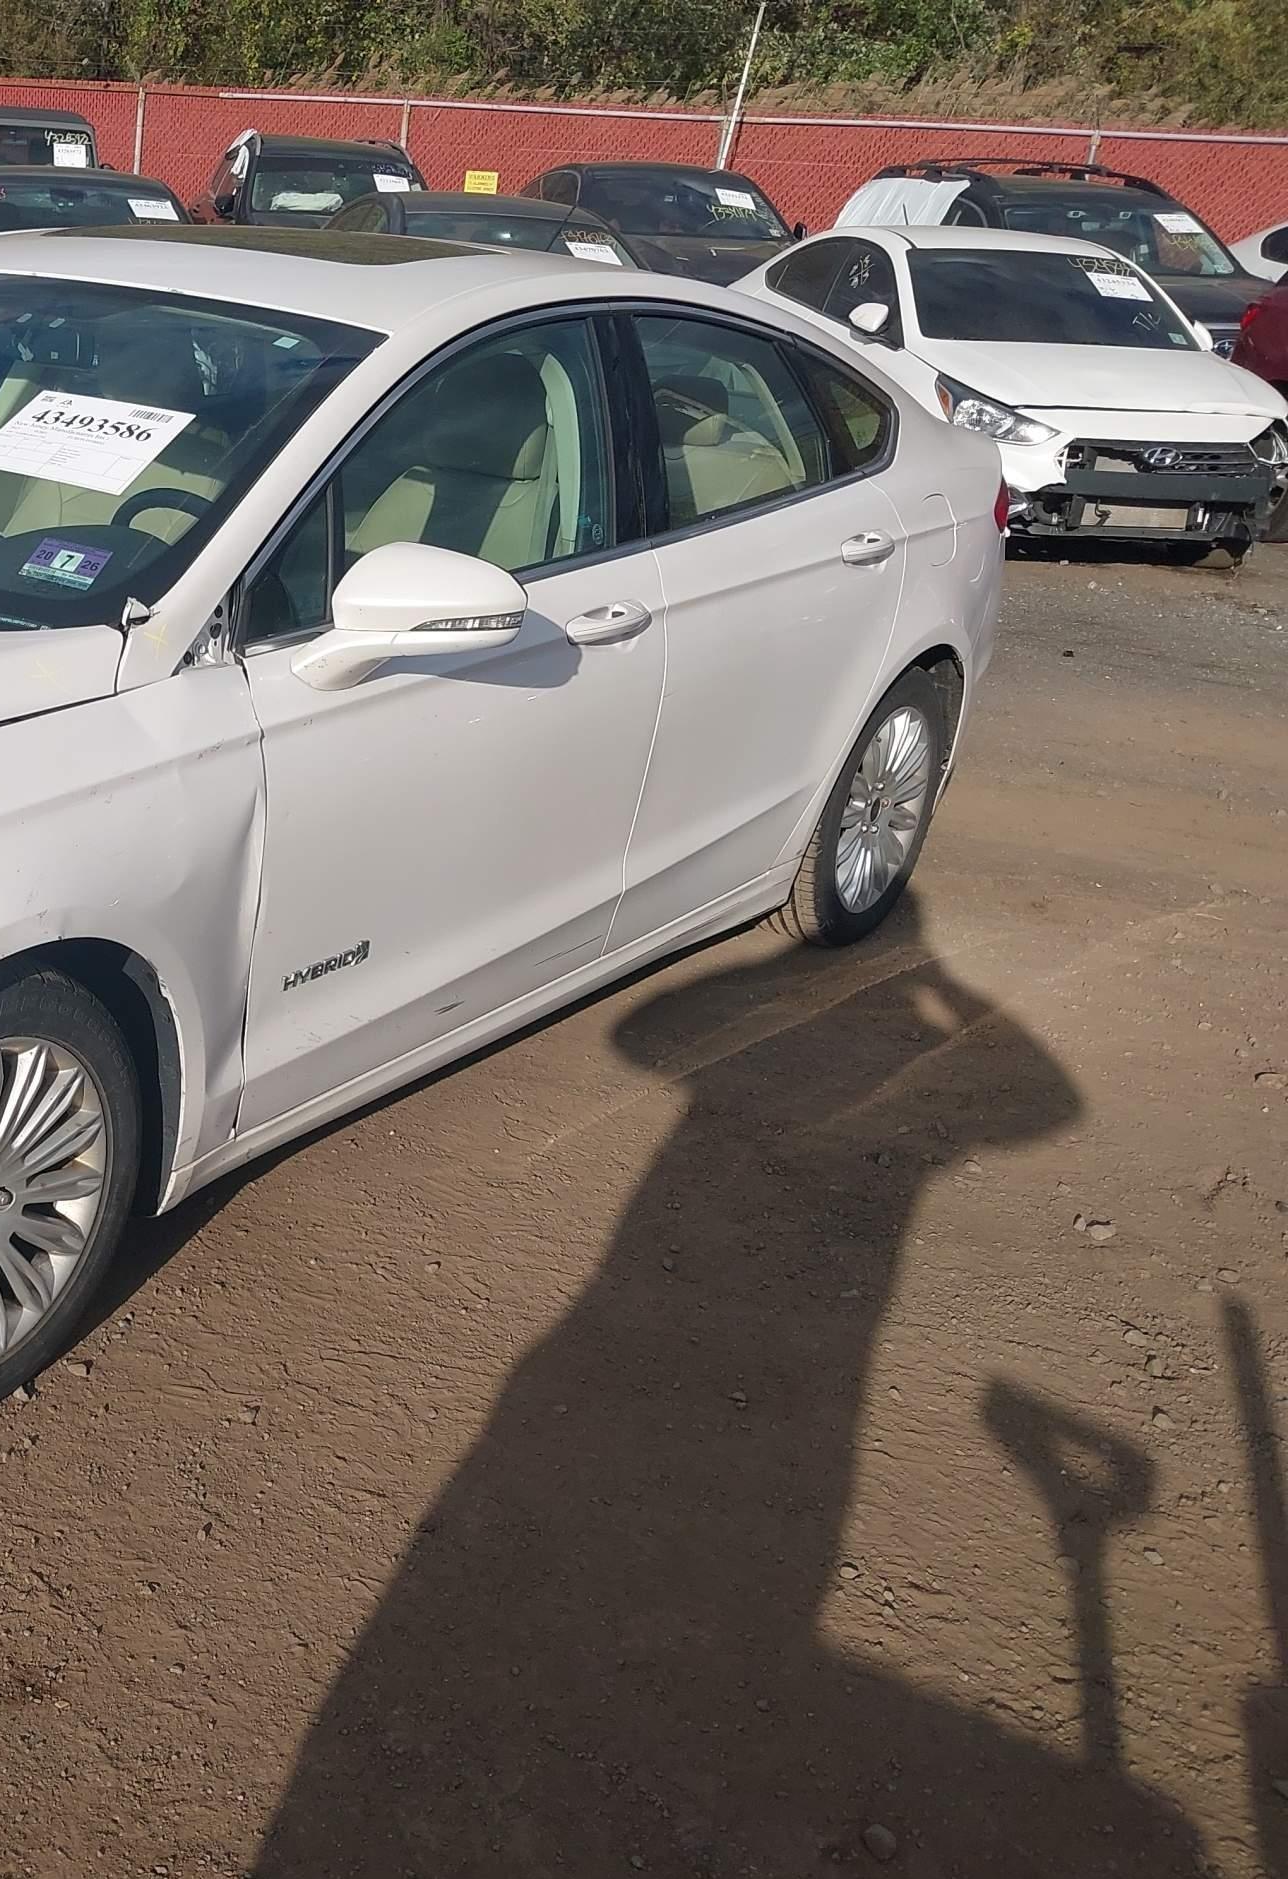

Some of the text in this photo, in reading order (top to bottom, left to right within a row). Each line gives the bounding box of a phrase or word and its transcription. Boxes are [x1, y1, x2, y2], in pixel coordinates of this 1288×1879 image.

[31, 409, 158, 442] 43493586
[36, 550, 100, 571] 20 7 26
[282, 948, 356, 991] HYBRID
